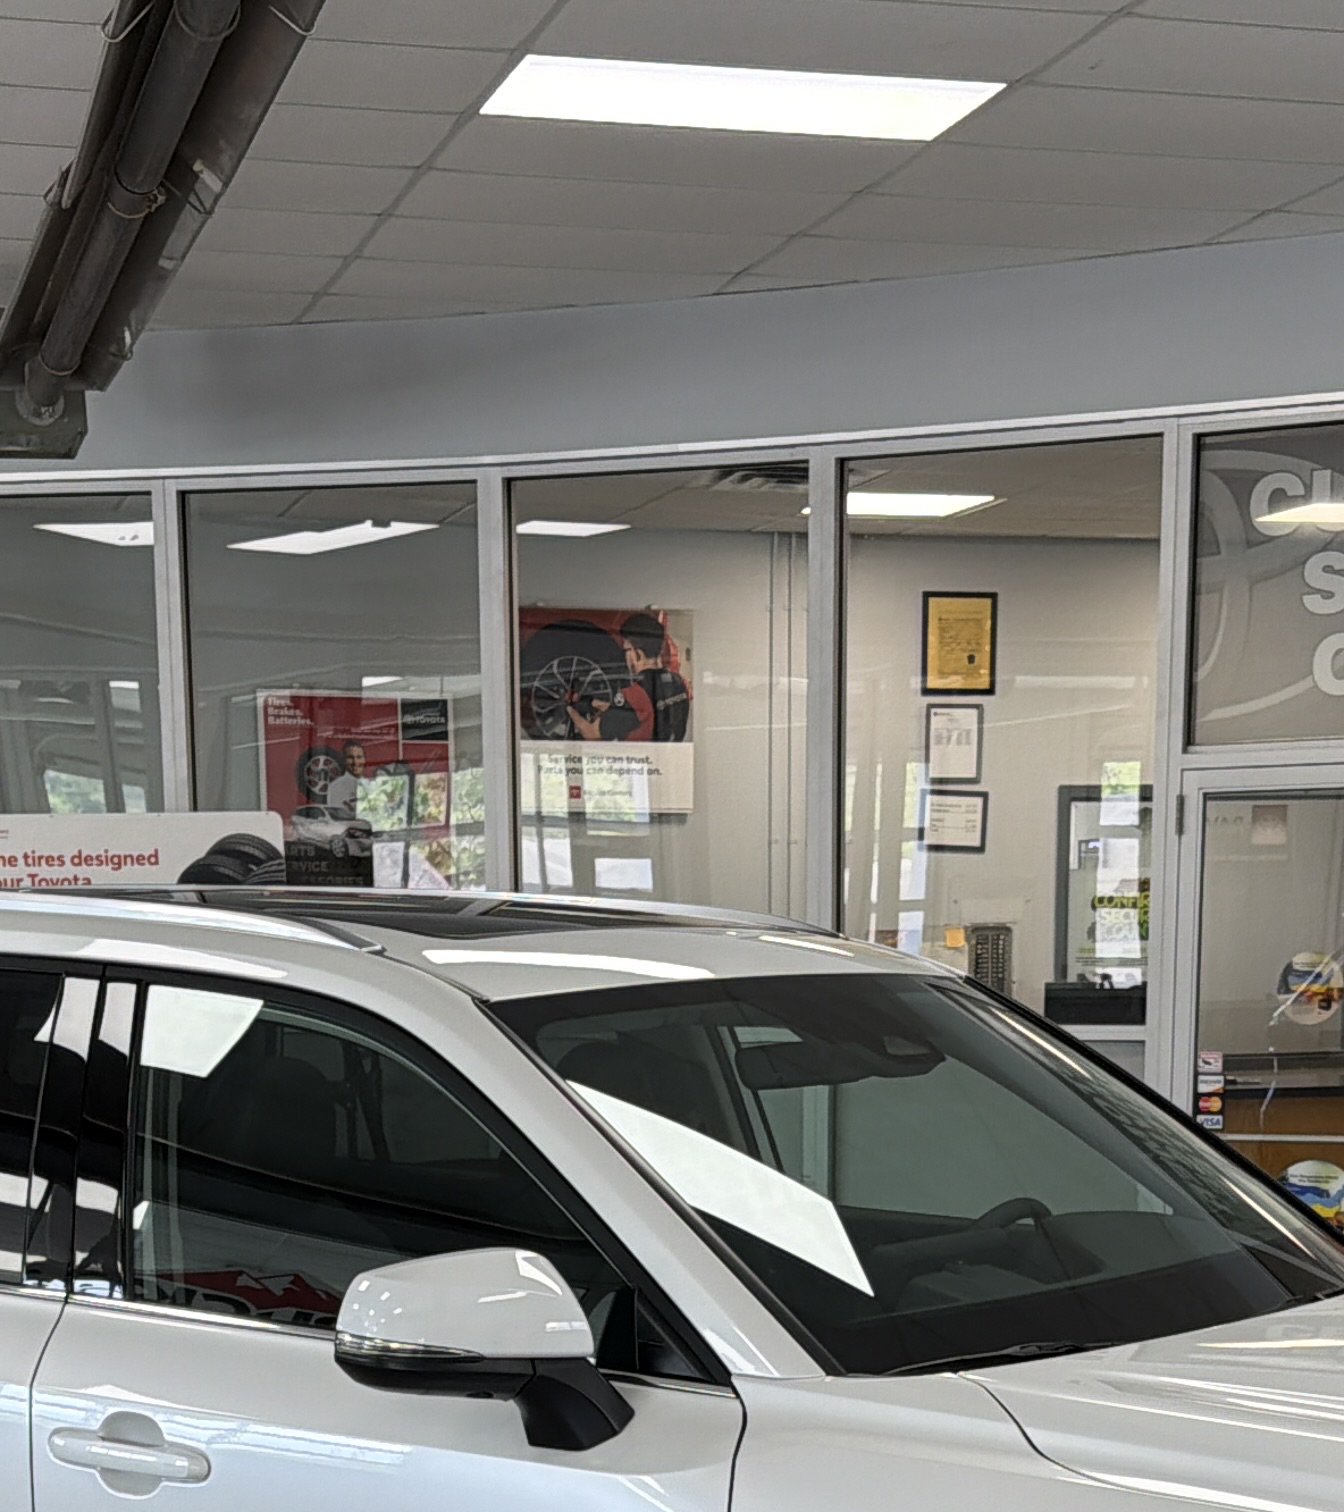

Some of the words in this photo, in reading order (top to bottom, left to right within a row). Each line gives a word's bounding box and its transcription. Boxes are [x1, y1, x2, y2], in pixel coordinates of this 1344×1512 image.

[267, 697, 295, 706] Tires.
[267, 706, 304, 716] Brakes.
[267, 716, 315, 725] Batteries.
[626, 755, 653, 765] trust.
[565, 766, 584, 776] you
[22, 849, 66, 868] tires
[69, 848, 160, 872] designed
[26, 872, 92, 887] Toyota
[1199, 1116, 1221, 1127] VISA
